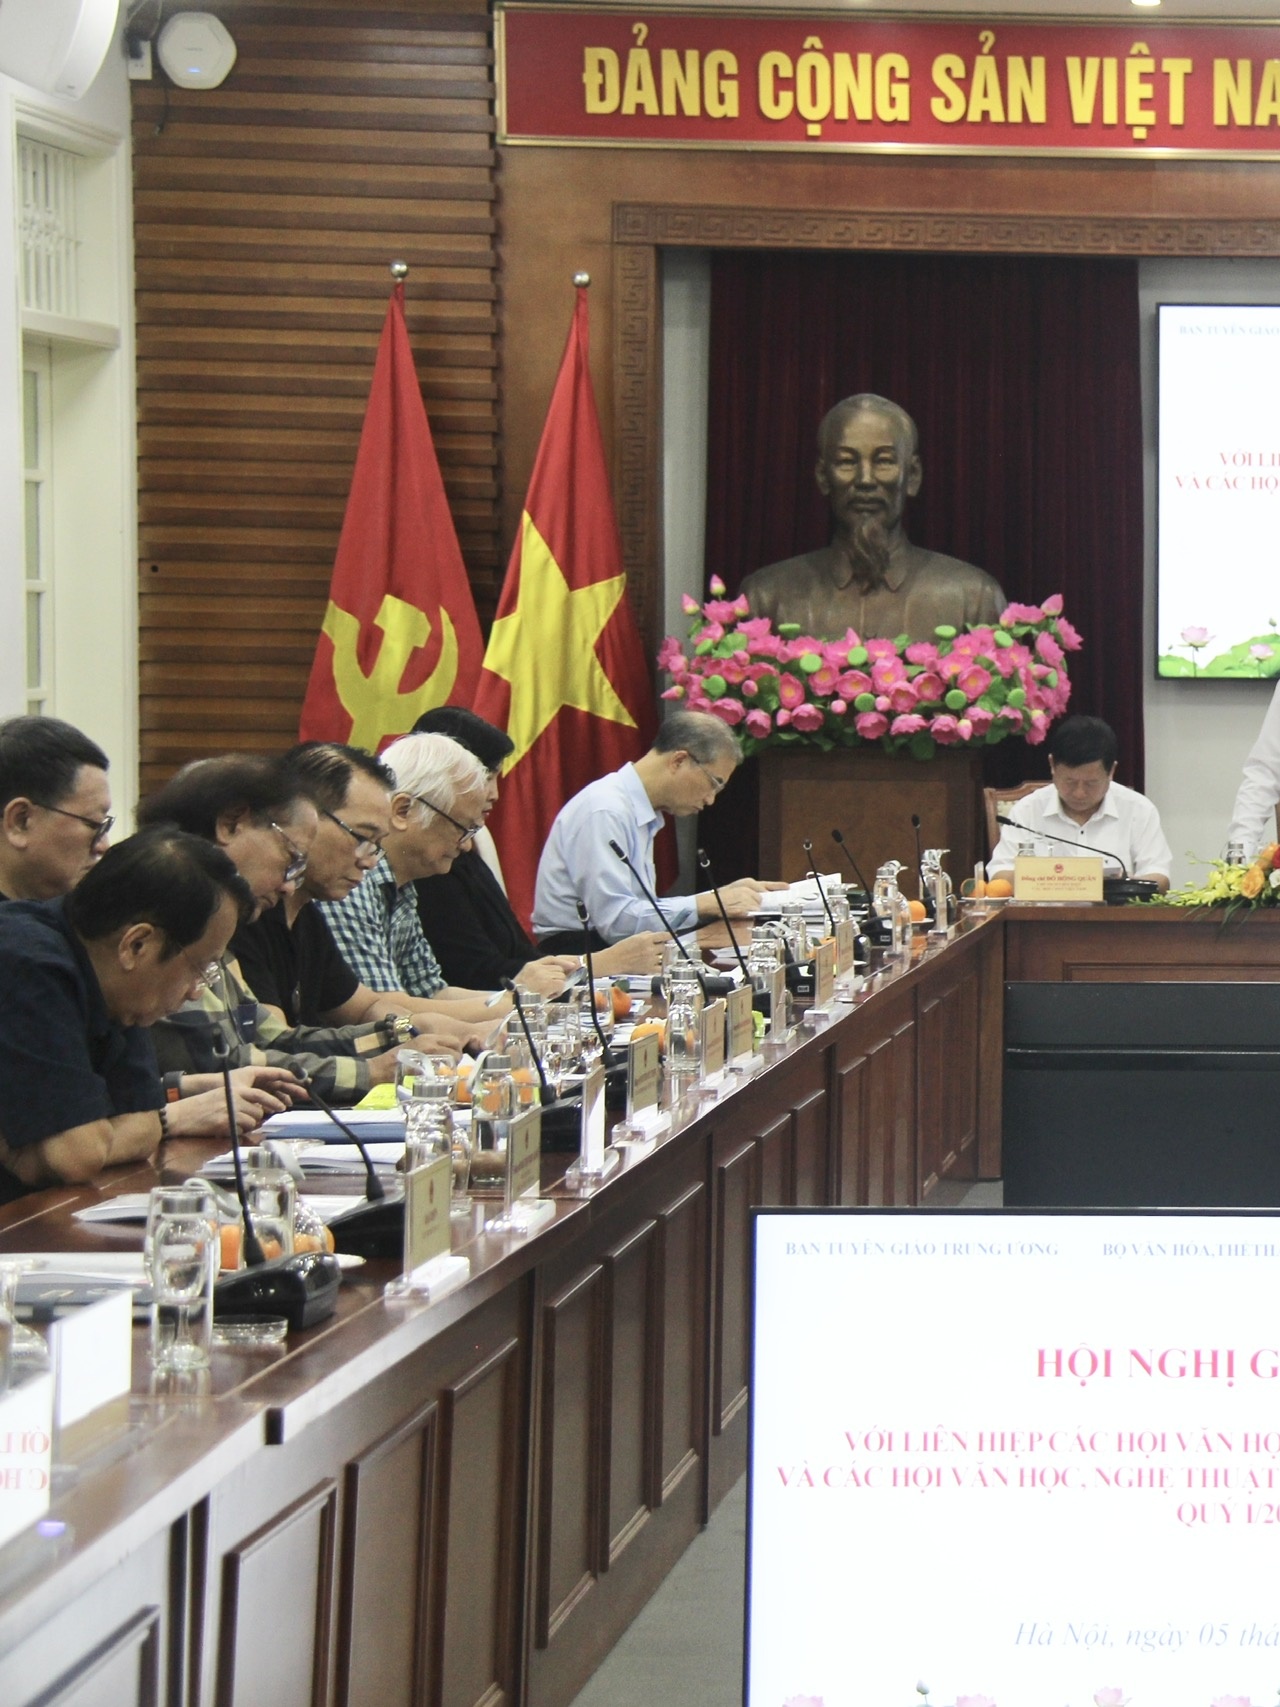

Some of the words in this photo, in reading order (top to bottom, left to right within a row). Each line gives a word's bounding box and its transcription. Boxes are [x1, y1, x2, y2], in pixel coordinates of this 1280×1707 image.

[583, 22, 739, 117] ĐẢNG
[758, 36, 910, 136] CỘNG
[930, 30, 1046, 124] SẢN
[1066, 42, 1193, 140] VIỆT
[785, 1241, 824, 1256] BAN
[827, 1237, 888, 1256] TUYÊN
[890, 1238, 937, 1256] GIÁO
[941, 1242, 1001, 1256] TRUNG
[1006, 1240, 1060, 1257] ƯƠNG
[1102, 1239, 1128, 1261] BỘ
[1131, 1239, 1170, 1257] VĂN
[1036, 1343, 1112, 1387] HỘI
[1129, 1349, 1235, 1388] NGHỊ
[843, 1424, 895, 1453] VỚI
[903, 1422, 972, 1453] LIÊN
[977, 1425, 1044, 1460] HIỆP
[1048, 1424, 1112, 1453] CÁC
[1117, 1426, 1168, 1461] HỘI
[1173, 1426, 1238, 1454] VĂN
[776, 1460, 818, 1488] VÀ
[822, 1460, 885, 1488] CÁC
[891, 1461, 943, 1495] HỘI
[949, 1461, 1013, 1488] VĂN
[1018, 1466, 1089, 1495] HỌC,
[1094, 1462, 1173, 1496] NGHỆ
[1179, 1463, 1280, 1496] THUẬT
[1176, 1496, 1238, 1528] QUÝ
[1014, 1621, 1055, 1648] Hà
[1062, 1621, 1115, 1651] Nội,
[1125, 1621, 1190, 1653] ngày
[1198, 1622, 1230, 1648] 05
